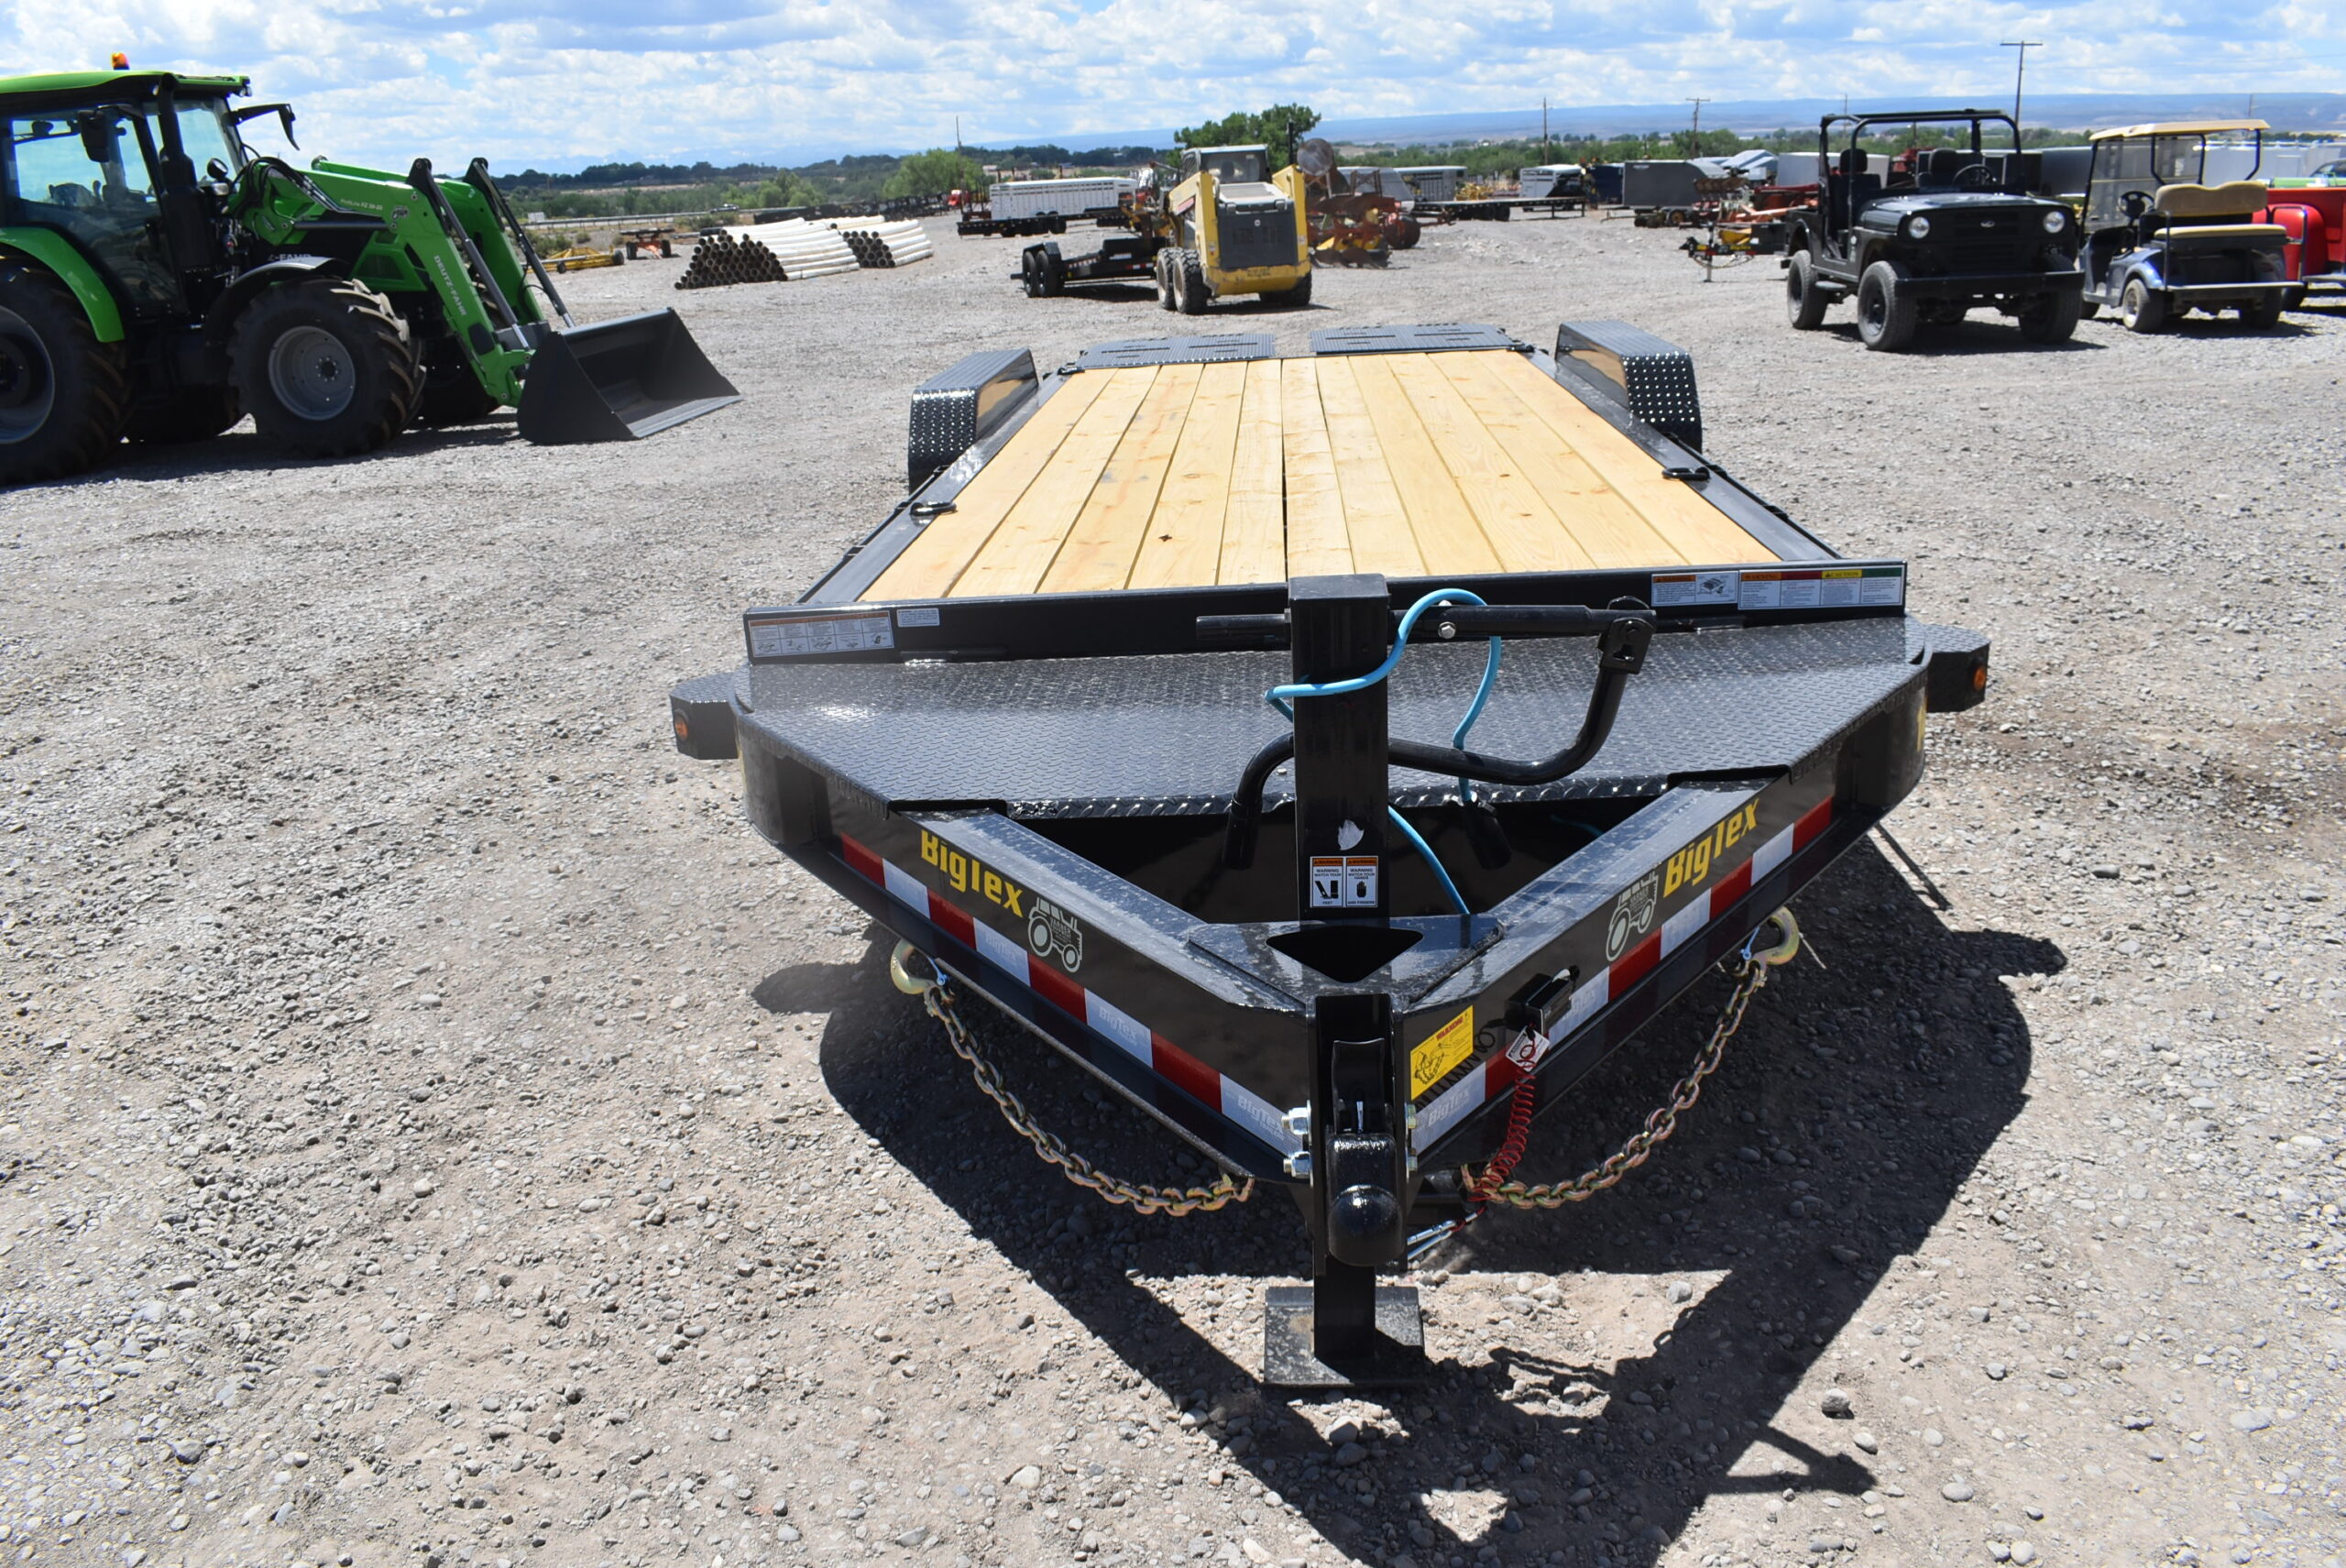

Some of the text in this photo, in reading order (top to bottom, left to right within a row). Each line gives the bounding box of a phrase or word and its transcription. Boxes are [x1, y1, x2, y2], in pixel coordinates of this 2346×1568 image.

[433, 255, 468, 316] DEUTZ-FAHR
[1099, 1005, 1137, 1039] BigTex
[1237, 1094, 1284, 1135] BigTex
[1428, 1088, 1471, 1127] BigTex
